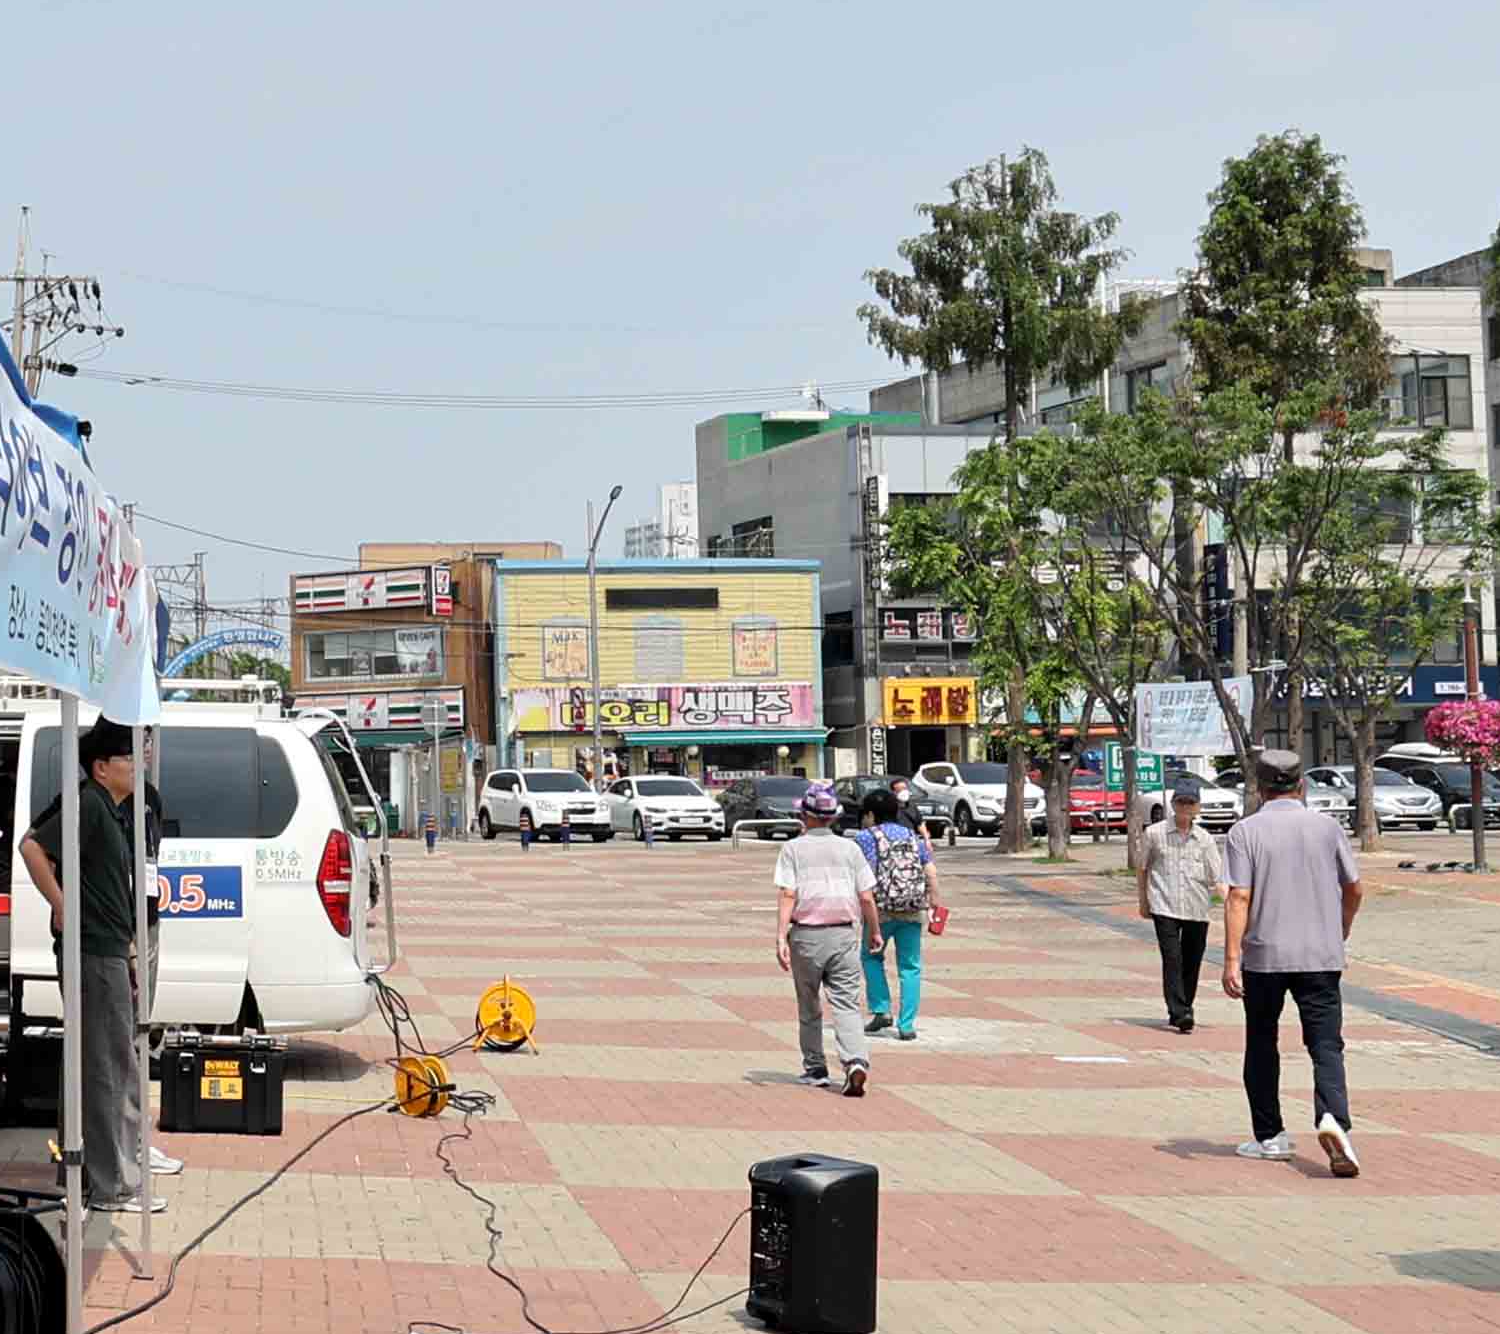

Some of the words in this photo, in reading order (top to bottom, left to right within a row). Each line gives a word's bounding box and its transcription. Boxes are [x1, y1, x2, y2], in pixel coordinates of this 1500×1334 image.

[678, 689, 793, 726] 생맥주
[892, 685, 970, 718] 노래방
[207, 899, 236, 911] MHz
